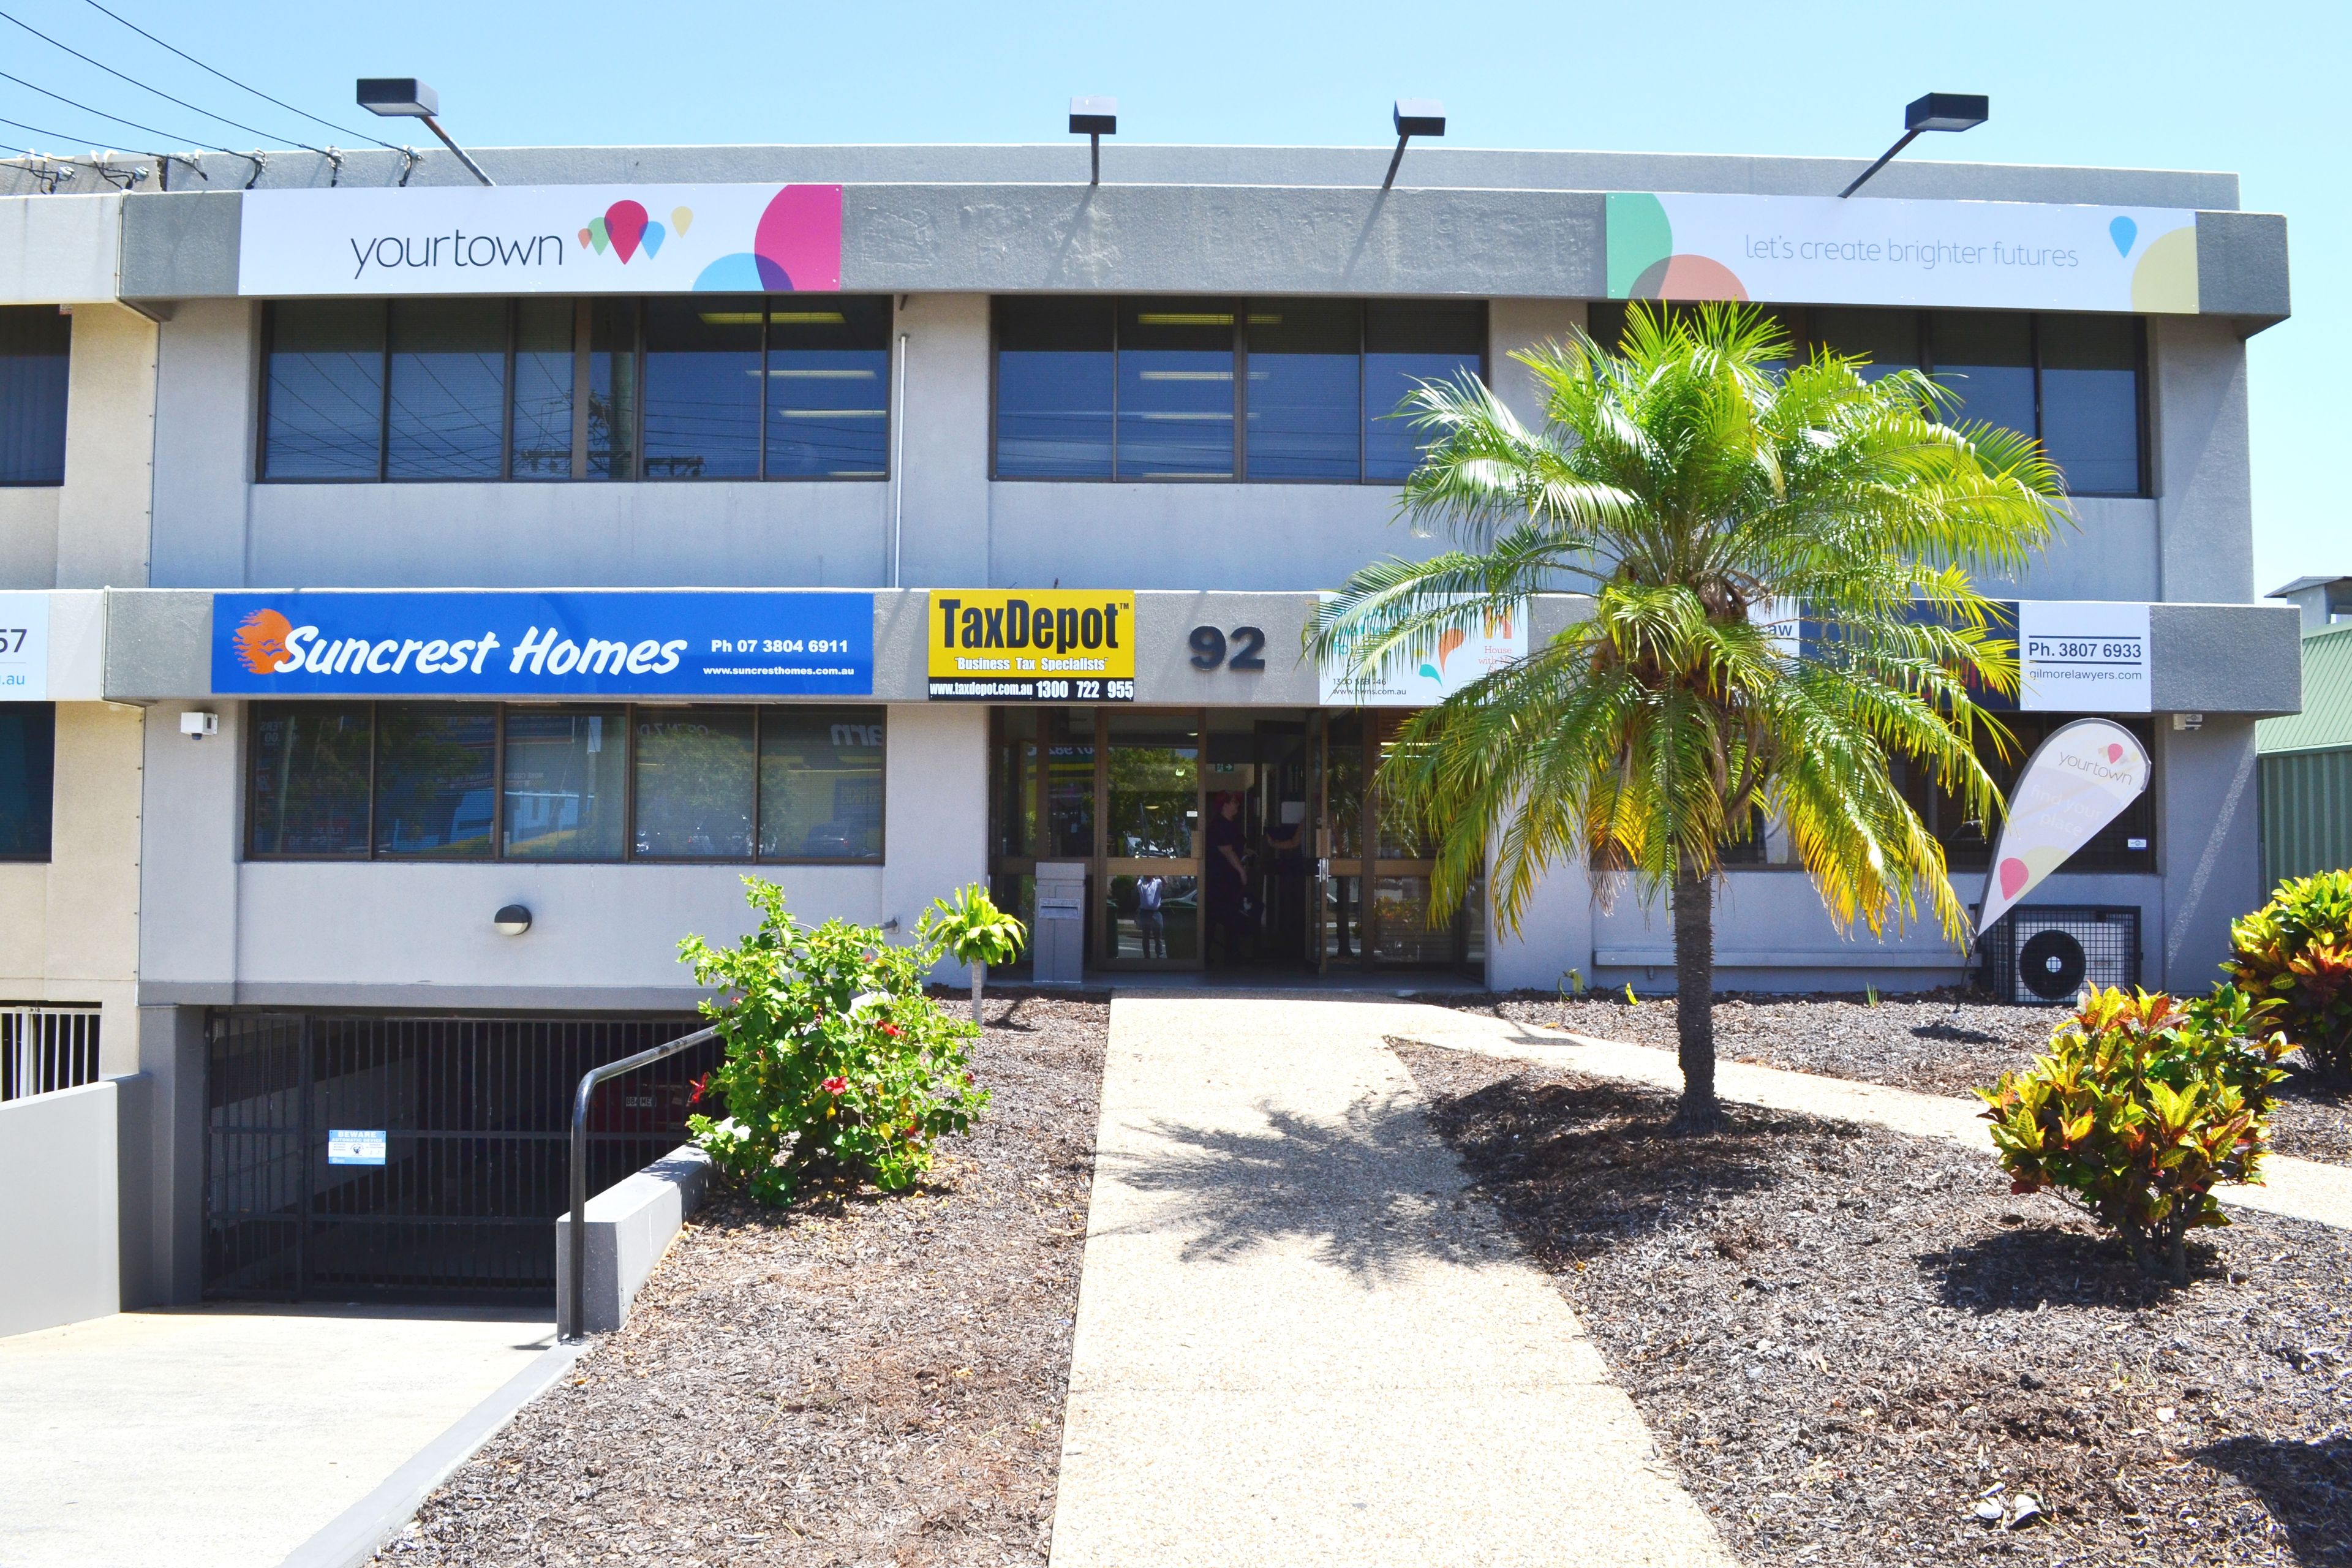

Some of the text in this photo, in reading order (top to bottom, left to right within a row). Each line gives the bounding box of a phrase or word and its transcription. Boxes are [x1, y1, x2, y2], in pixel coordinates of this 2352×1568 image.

[350, 228, 564, 280] yourtown
[1746, 235, 2079, 270] let's create brighter futures
[939, 598, 1120, 654] TaxDepot
[273, 625, 688, 675] Suncrest Homes
[711, 639, 848, 653] Ph 07 3804 6911
[1189, 625, 1266, 672] 92
[2029, 642, 2141, 658] Ph. 3807 6933
[703, 666, 854, 675] www.suncresthomes.com.au
[1015, 657, 1036, 670] Tax
[1478, 656, 1497, 665] with
[0, 674, 25, 685] .au
[2029, 669, 2142, 682] gilmorelawyers.com
[929, 680, 1133, 699] www.taxdepot.com.au 1300 722 955
[2058, 752, 2132, 786] yourtown
[2030, 784, 2103, 820] find your
[2039, 813, 2083, 837] place
